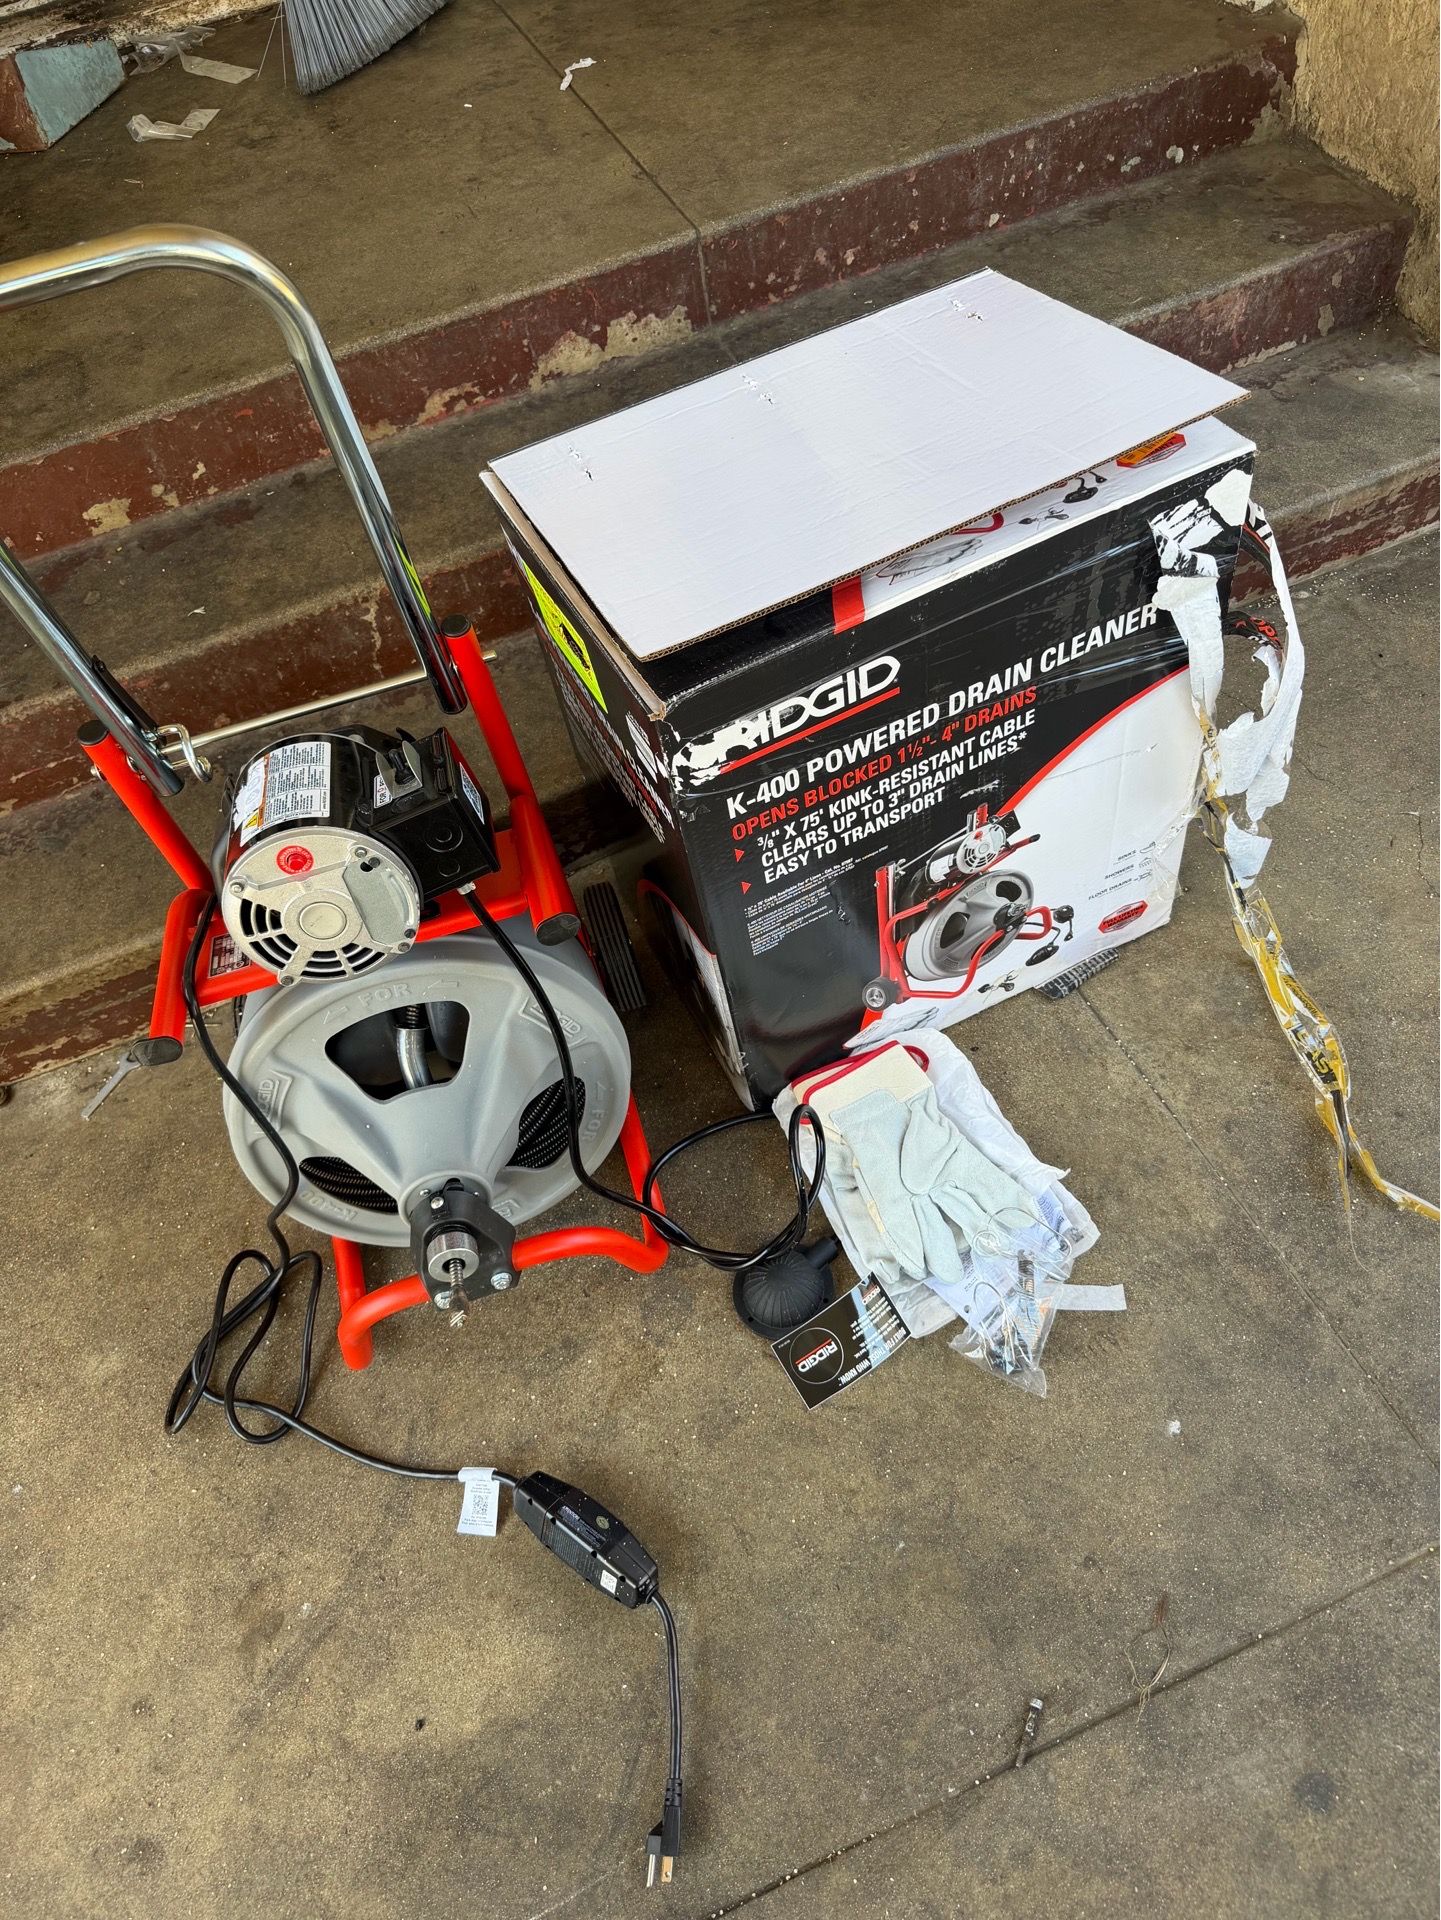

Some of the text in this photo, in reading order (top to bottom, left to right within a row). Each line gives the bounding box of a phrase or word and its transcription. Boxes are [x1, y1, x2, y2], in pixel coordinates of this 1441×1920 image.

[727, 603, 1158, 819] K-400 POWERED DRAIN CLEANER
[731, 798, 800, 841] OPENS
[804, 753, 892, 807] BLOCKED
[942, 721, 960, 742] 4"
[963, 685, 1037, 735] DRAINS
[785, 823, 797, 840] X
[829, 736, 976, 818] KINK-RESISTANT
[979, 708, 1036, 748] CABLE
[761, 827, 828, 867] CLEARS
[834, 813, 858, 833] UP
[863, 802, 885, 820] TO
[888, 789, 906, 808] 3"
[908, 760, 964, 799] DRAIN
[763, 853, 811, 884] EASY
[815, 837, 838, 860] TO
[844, 786, 946, 842] TRANSPORT
[358, 983, 412, 1008] FOR
[798, 1341, 838, 1373] RIDGID
[857, 1359, 871, 1374] WHO
[893, 1327, 907, 1344] BUILT
